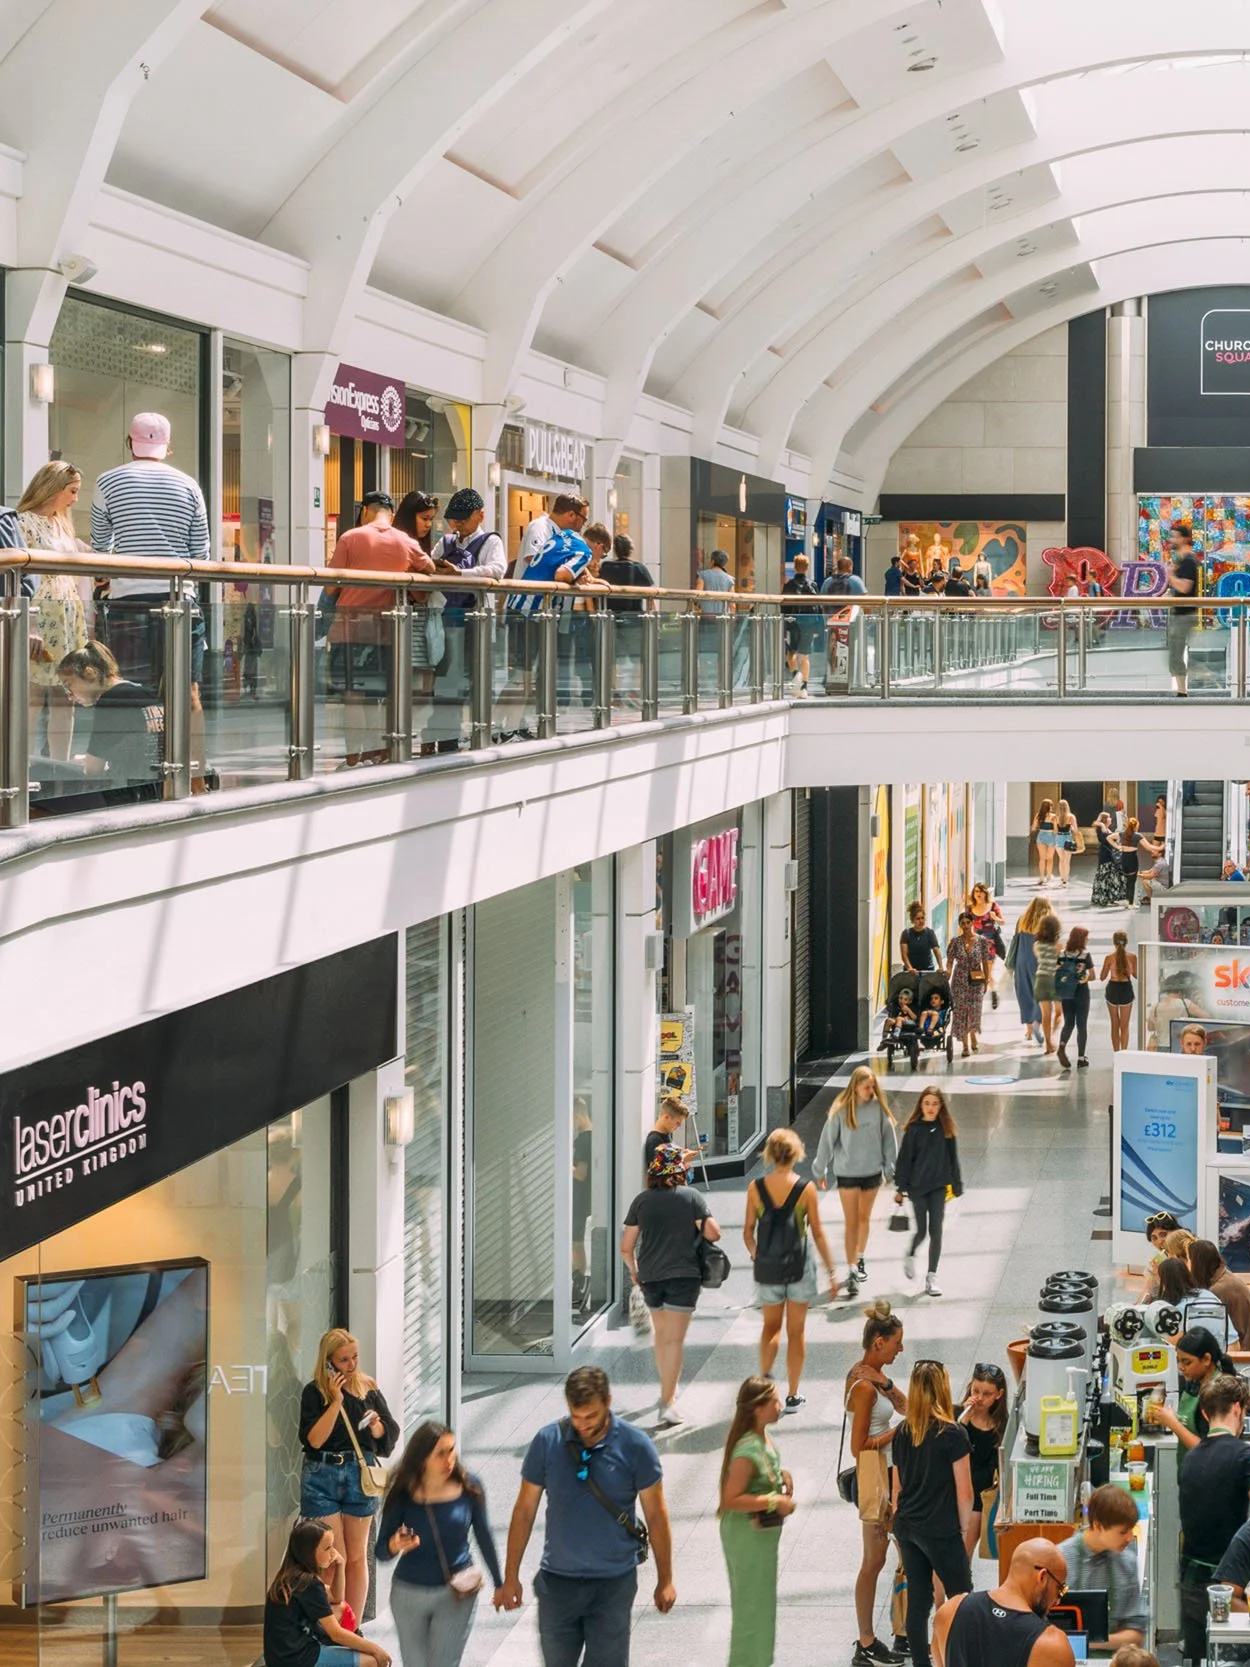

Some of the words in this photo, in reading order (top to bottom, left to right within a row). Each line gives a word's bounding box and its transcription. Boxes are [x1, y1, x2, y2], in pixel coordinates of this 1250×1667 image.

[528, 428, 586, 480] PULL&BEAR
[692, 827, 739, 917] GAME
[1144, 1122, 1176, 1139] £312
[14, 1167, 74, 1207] UNITED
[82, 1133, 147, 1176] KINGDOM
[1024, 1474, 1060, 1488] HIRING
[1040, 1493, 1057, 1501] Time
[41, 1524, 88, 1541] reduce
[91, 1512, 158, 1533] unwanted
[161, 1498, 189, 1523] hair
[42, 1503, 127, 1525] Permanently
